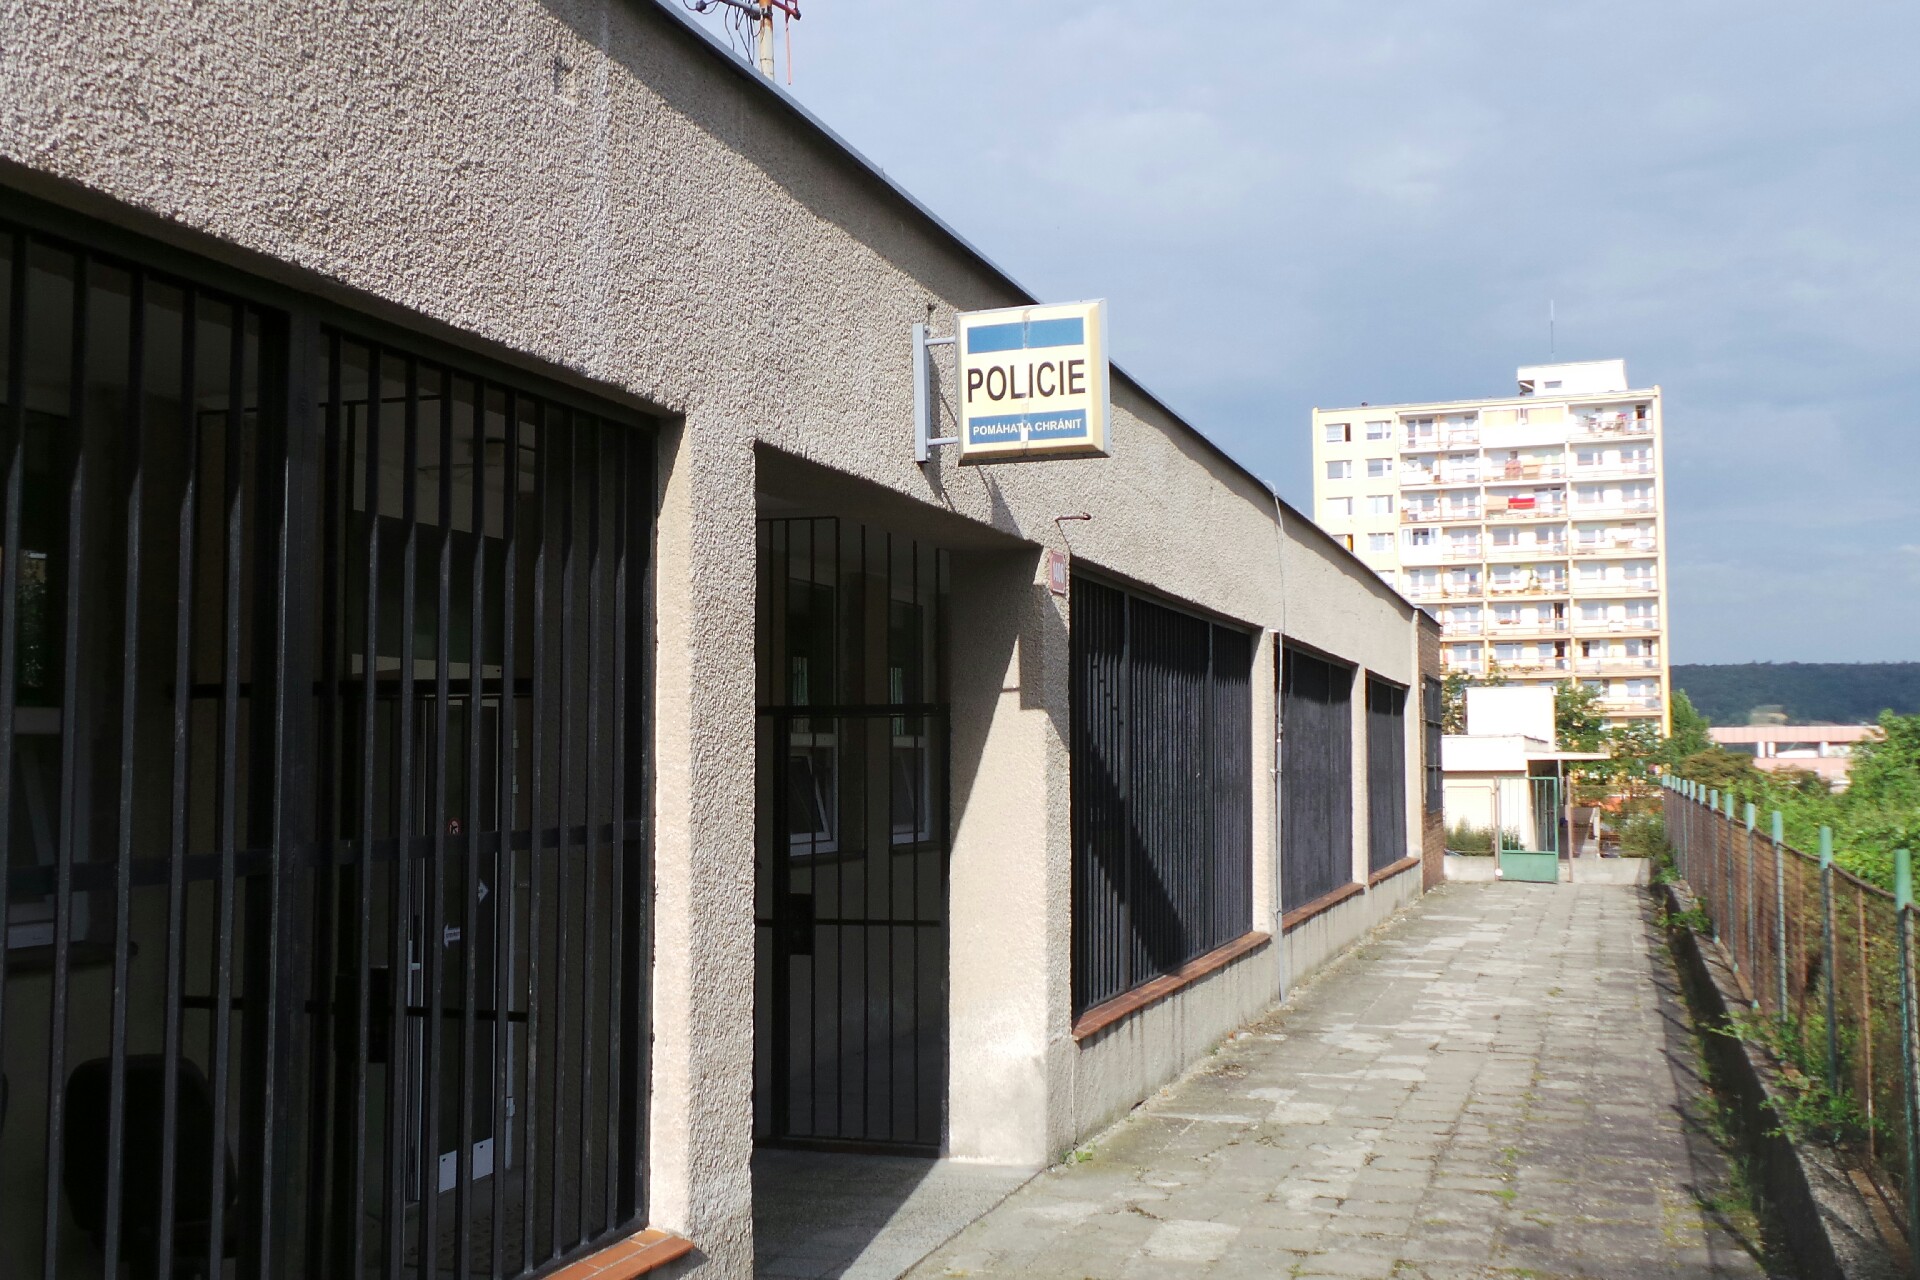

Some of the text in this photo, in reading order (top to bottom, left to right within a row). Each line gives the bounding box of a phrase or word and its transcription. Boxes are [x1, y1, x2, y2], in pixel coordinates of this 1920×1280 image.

[967, 359, 1086, 403] POLICIE
[973, 418, 1082, 436] POMÁHAT A CHRÁNIT
